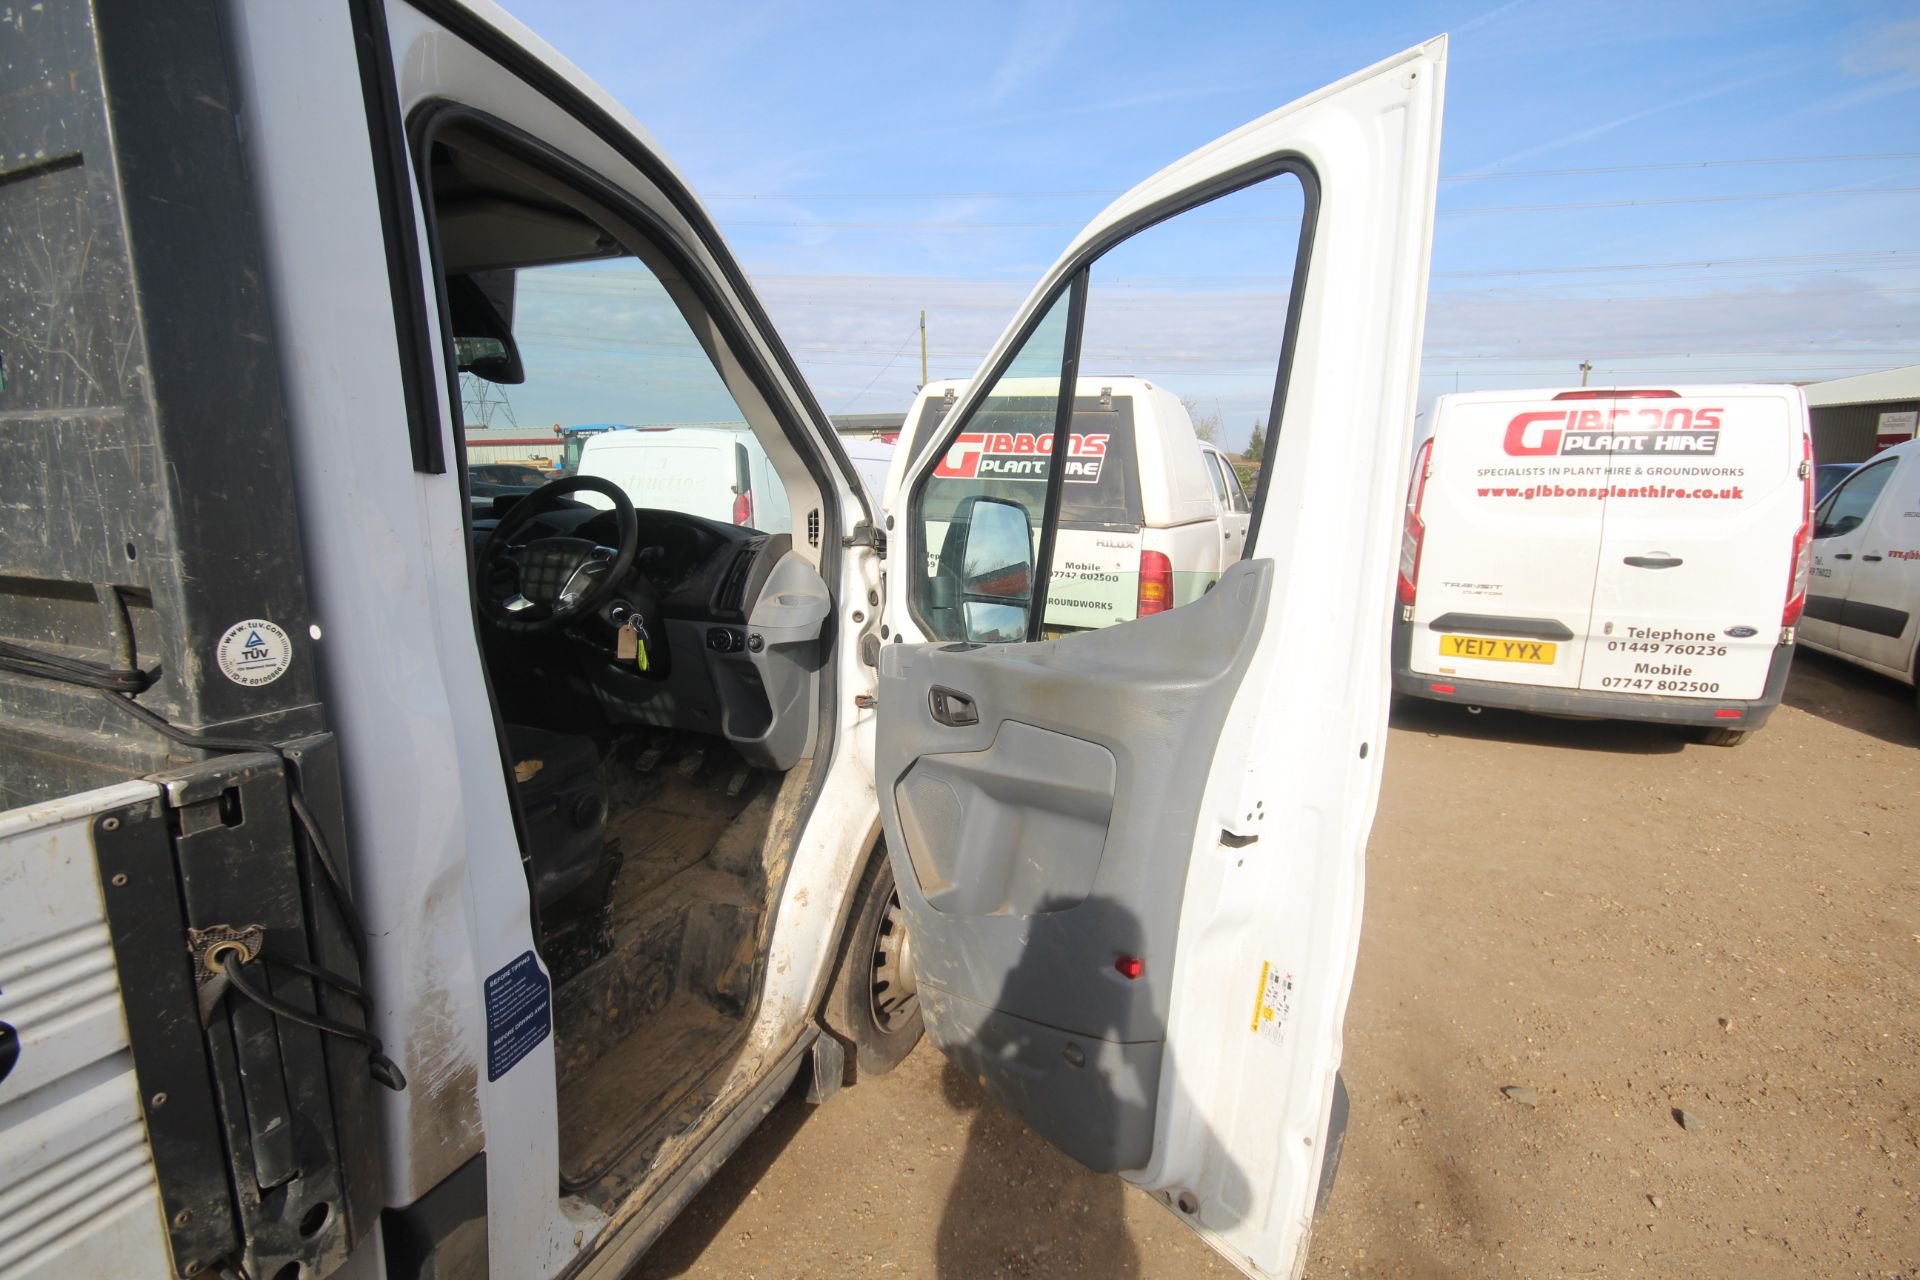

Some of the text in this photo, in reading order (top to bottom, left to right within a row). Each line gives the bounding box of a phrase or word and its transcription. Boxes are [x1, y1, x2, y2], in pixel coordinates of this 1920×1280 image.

[1564, 435, 1716, 450] PLANT HIRE
[980, 460, 1100, 475] PLANT IRE
[1477, 467, 1745, 477] SPECIALISTS IN PLANT HIRE & GROUNDWORKS
[1477, 485, 1744, 500] www.gibbonsplanthire.co.uk
[1065, 562, 1101, 571] Mobile
[1080, 573, 1119, 583] 802500
[1442, 582, 1503, 590] TRANSIT
[1047, 597, 1113, 610] ROUNDWORKS
[1627, 627, 1716, 642] Telephone
[241, 648, 269, 660] TÜV
[1454, 638, 1543, 660] YE17 YYX
[1607, 641, 1728, 656] 01449 760236
[1634, 663, 1692, 676] Mobile
[1602, 677, 1720, 693] 07747 802500
